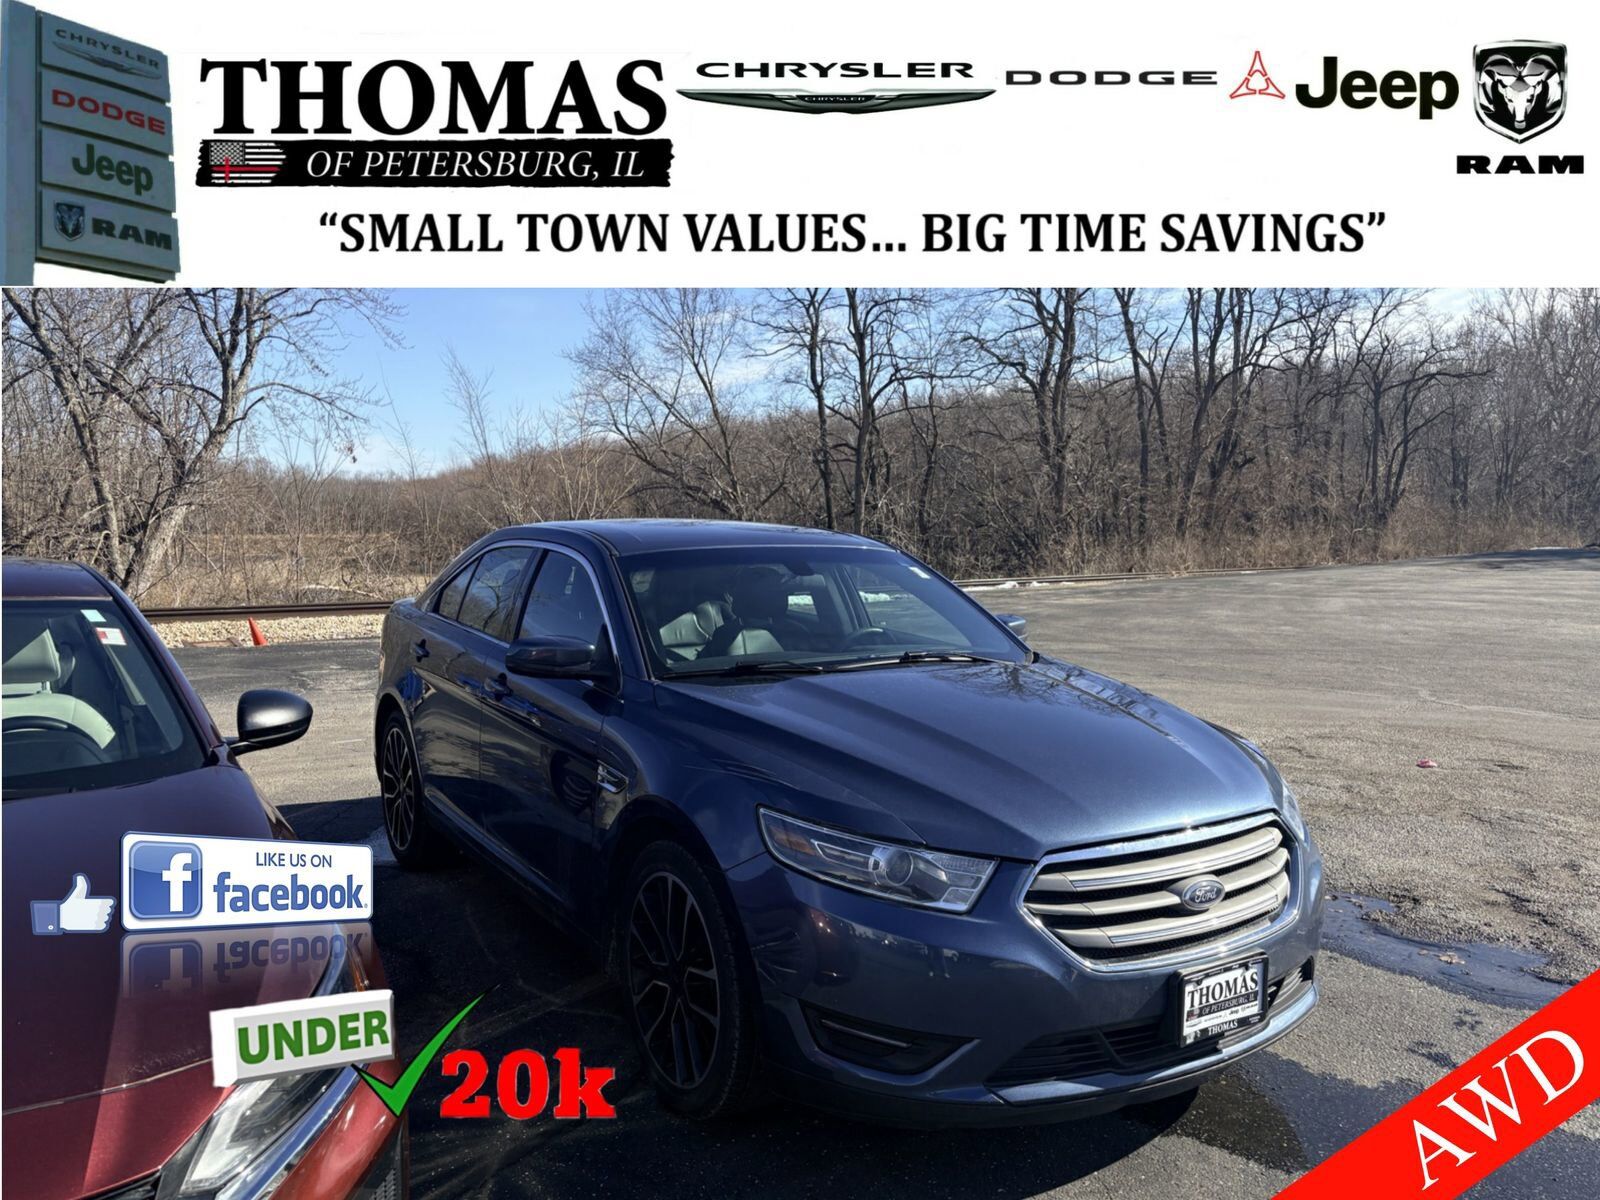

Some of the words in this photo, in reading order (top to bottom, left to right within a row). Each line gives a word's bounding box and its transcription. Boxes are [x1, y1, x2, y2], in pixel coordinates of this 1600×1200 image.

[1194, 885, 1217, 903] Ford
[1187, 971, 1258, 1009] THOMAS
[1207, 1019, 1238, 1036] THOMAS
